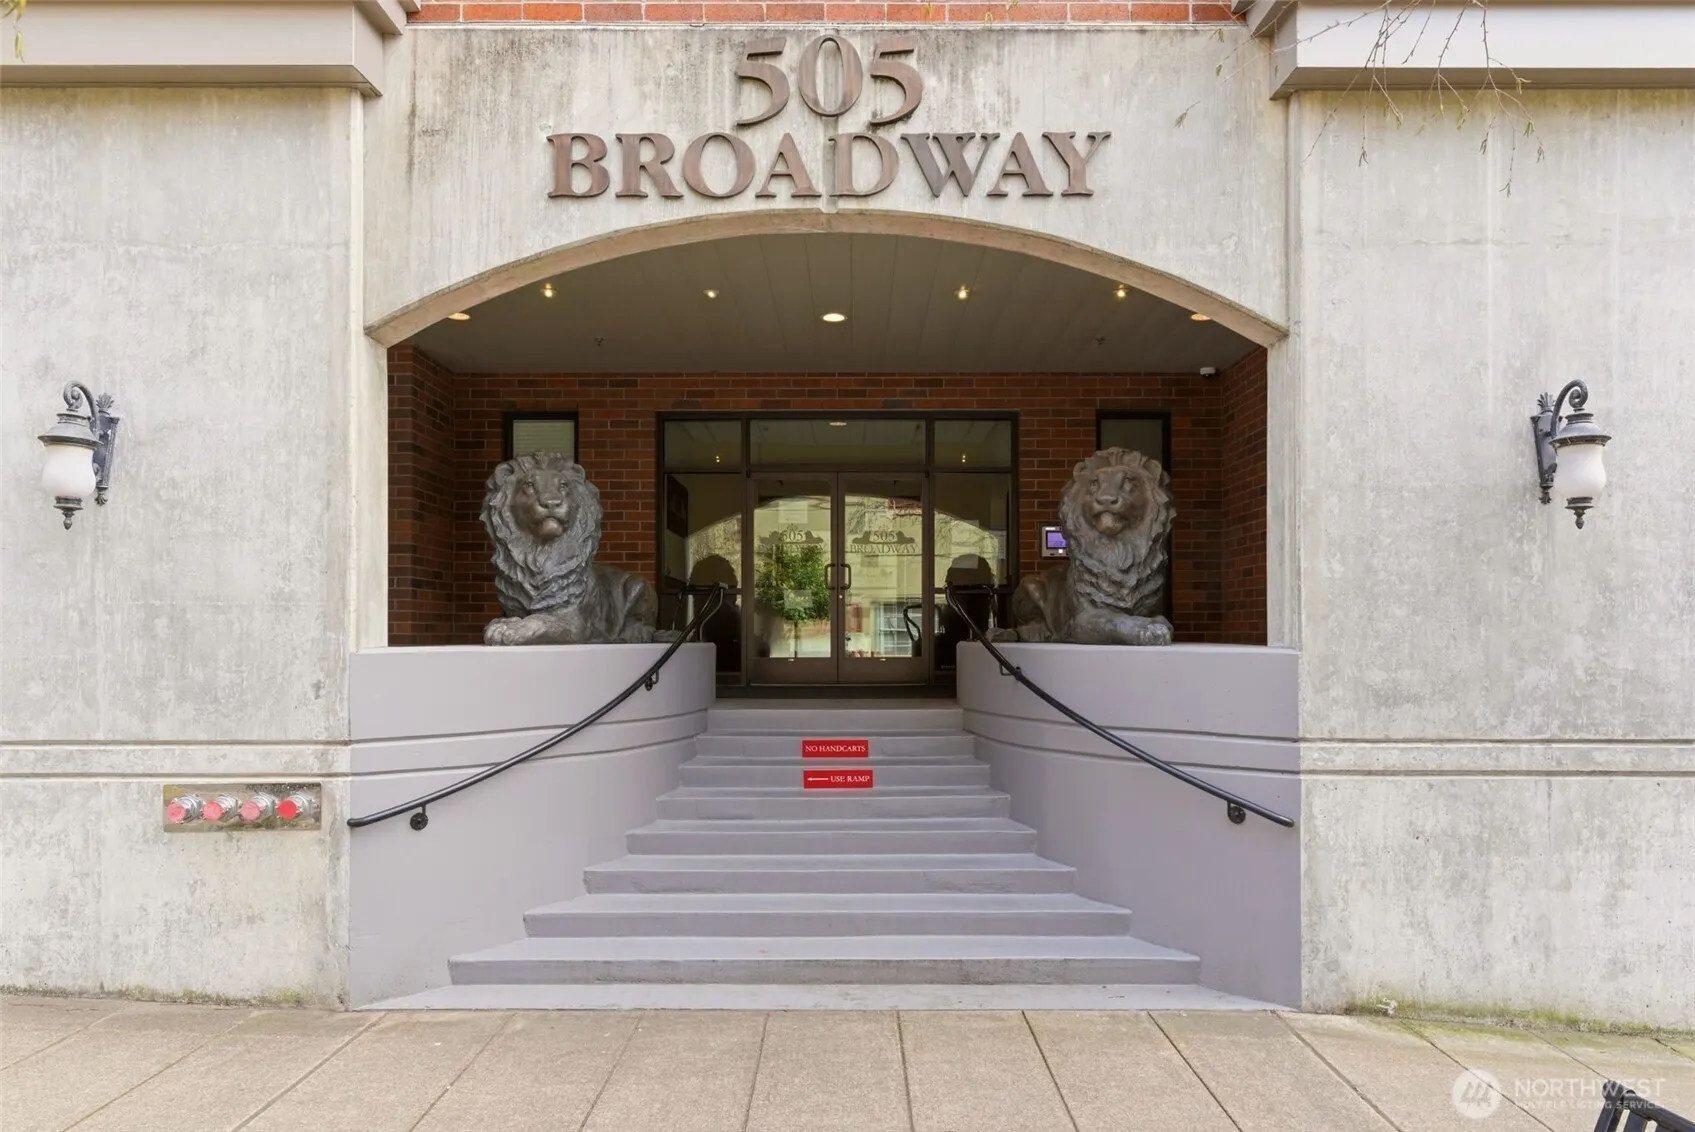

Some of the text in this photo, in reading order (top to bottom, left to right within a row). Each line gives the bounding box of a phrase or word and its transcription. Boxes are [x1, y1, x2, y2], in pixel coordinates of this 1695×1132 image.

[735, 34, 924, 127] 505
[546, 131, 1112, 198] BROADWAY
[782, 530, 803, 541] 505
[873, 530, 895, 541] 505
[850, 544, 919, 553] BROADWAY
[830, 775, 870, 783] USE RAMP
